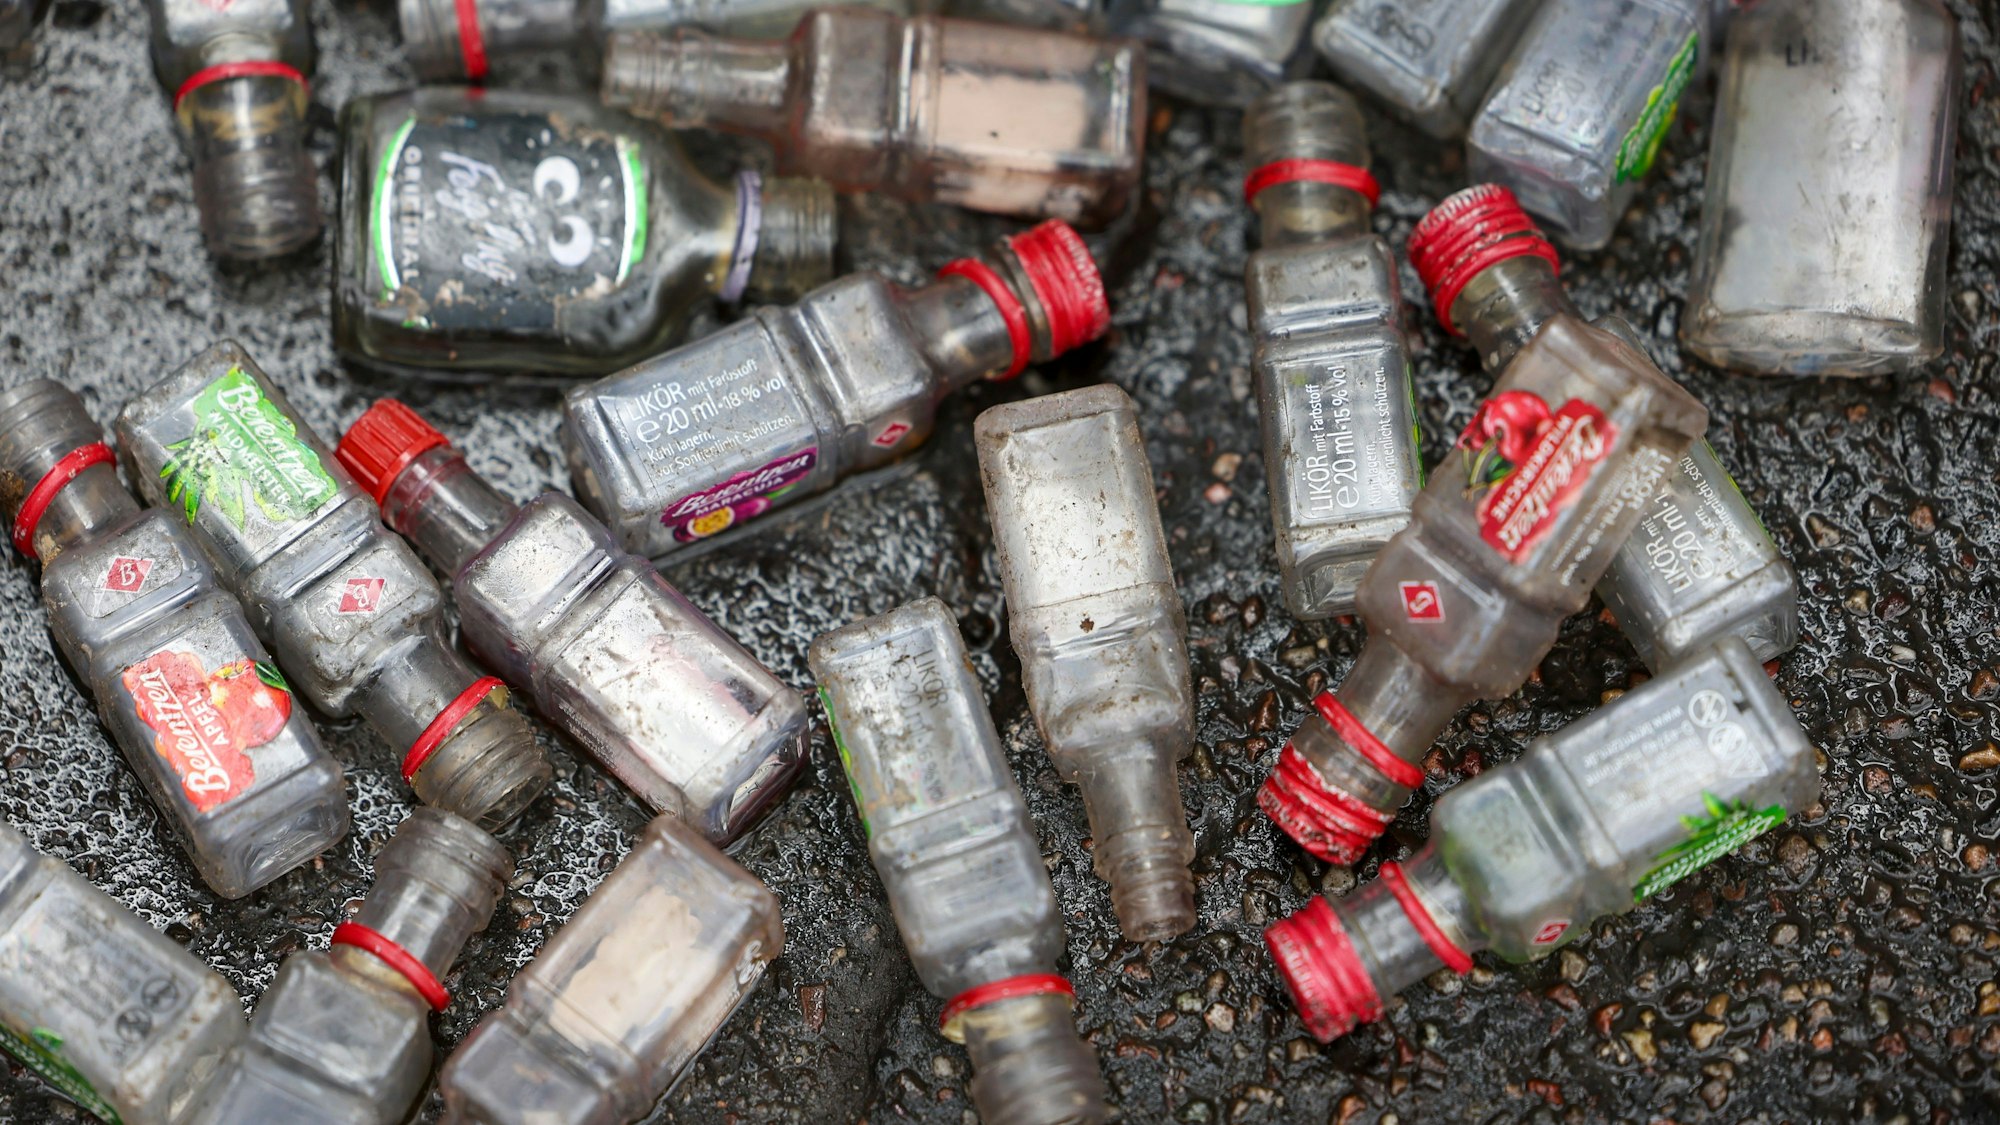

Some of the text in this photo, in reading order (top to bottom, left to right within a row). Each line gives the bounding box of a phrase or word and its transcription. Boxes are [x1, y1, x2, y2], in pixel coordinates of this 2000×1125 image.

[622, 382, 686, 420] LIKÖR
[687, 380, 708, 396] mit
[1327, 363, 1346, 387] vol
[1331, 389, 1349, 405] %
[1374, 366, 1389, 416] schützen.
[218, 375, 331, 500] Berentzen
[659, 407, 689, 434] 20
[1299, 384, 1333, 510] LIKÖR mit Farbstoff
[1378, 418, 1397, 480] Sonnenlicht
[207, 412, 290, 505] WALDMEISTER
[672, 453, 810, 518] Berentzen
[1331, 458, 1358, 484] 20
[1492, 416, 1571, 519] WILDKIRSCHE
[1498, 415, 1604, 558] Berentzen
[696, 475, 784, 516] MARACUJA
[1696, 480, 1740, 542] Sonnenlicht
[1642, 517, 1692, 596] LIKÖR mit
[139, 668, 231, 795] Berentzen
[194, 691, 230, 746] APFEL
